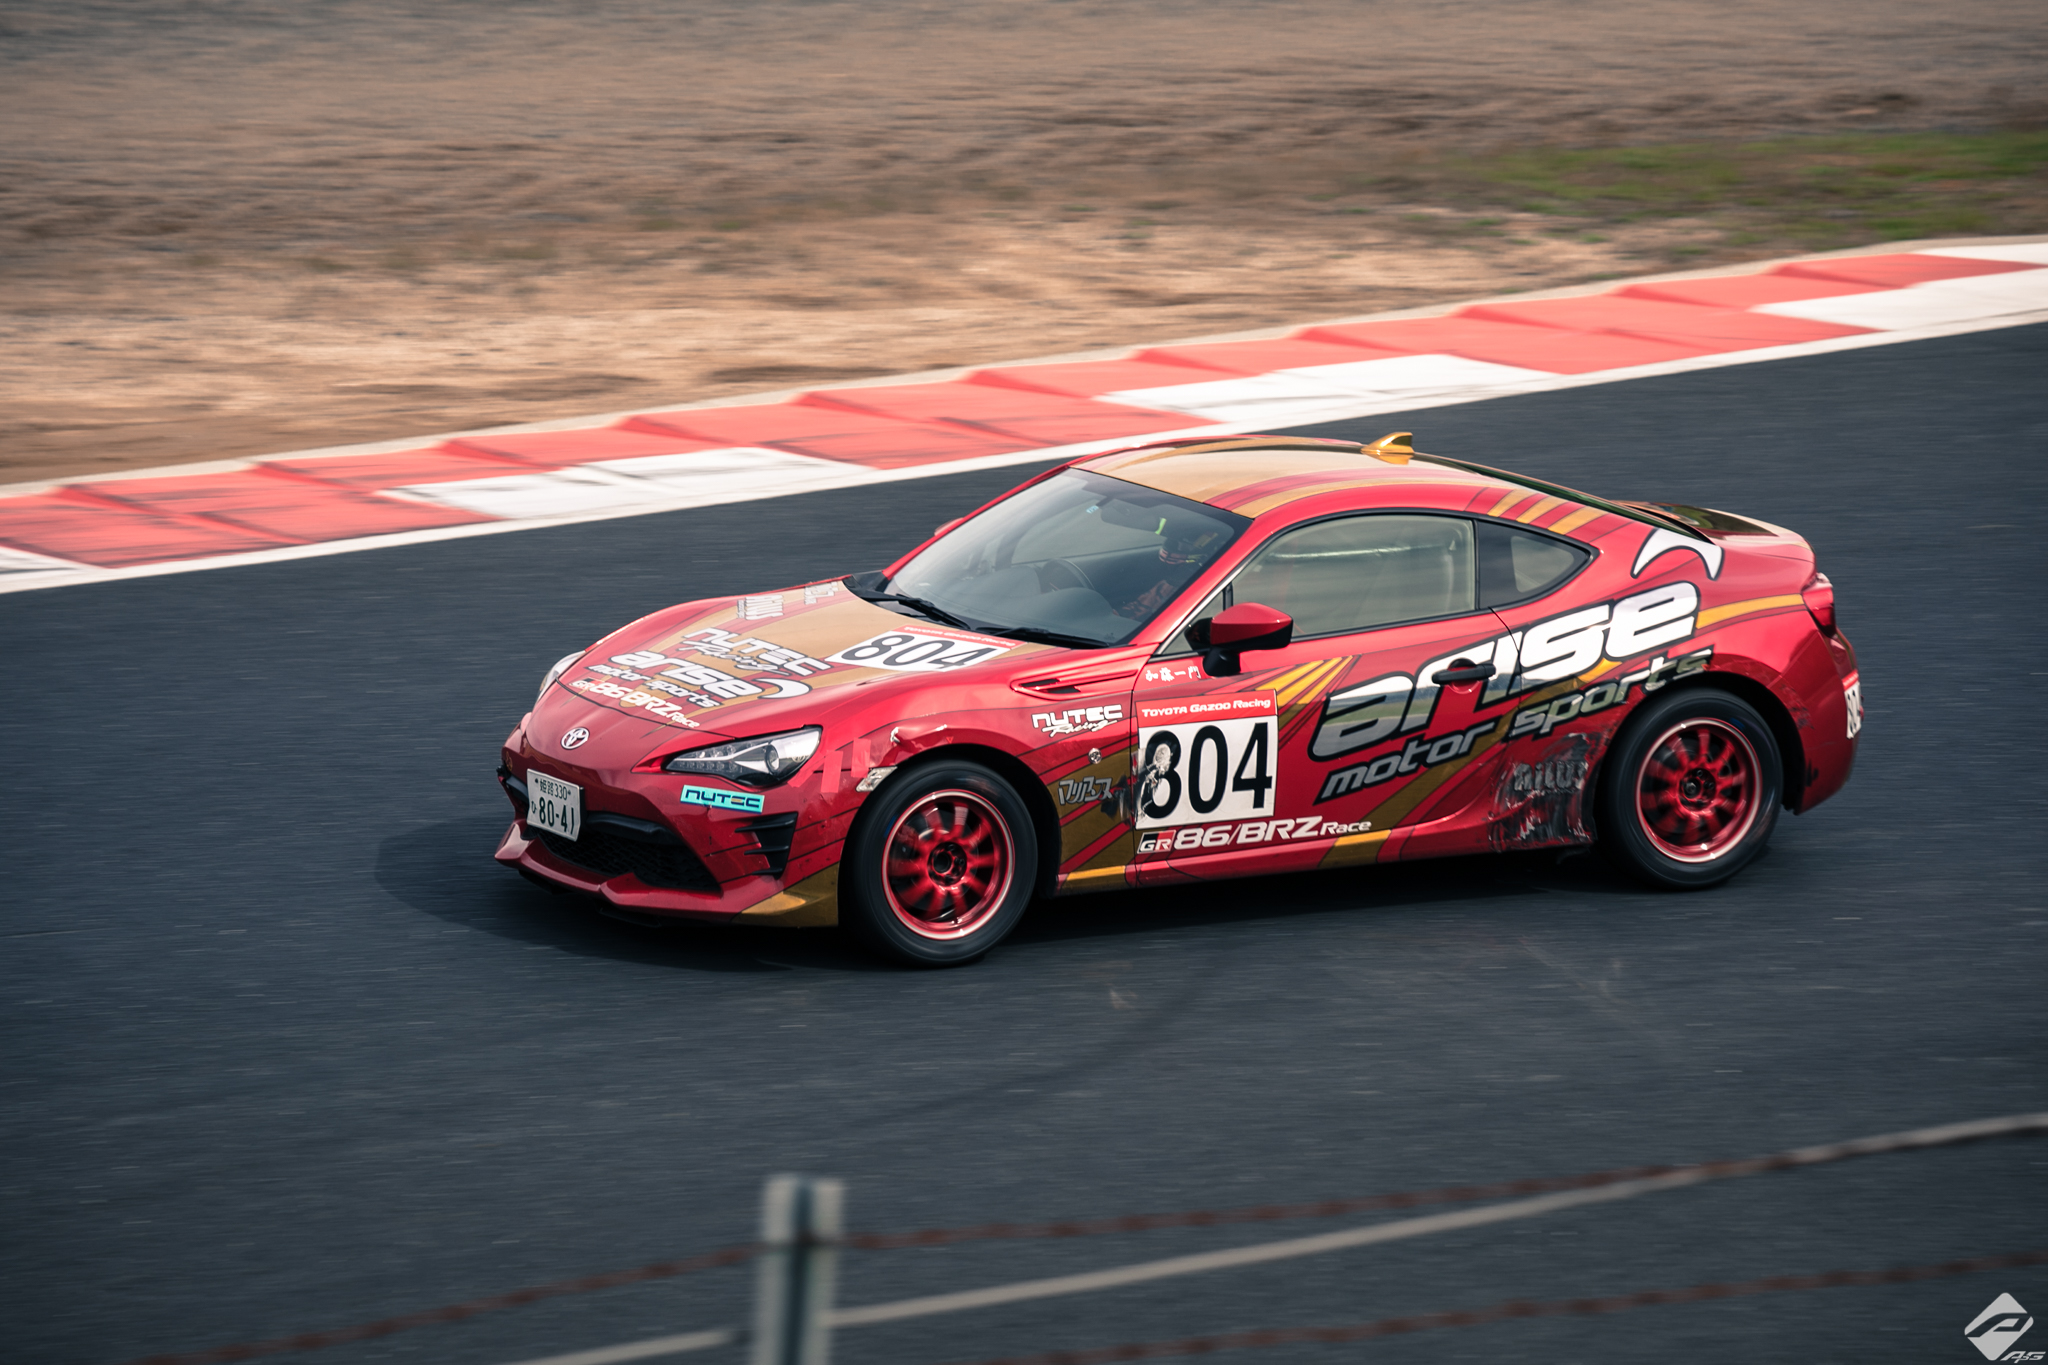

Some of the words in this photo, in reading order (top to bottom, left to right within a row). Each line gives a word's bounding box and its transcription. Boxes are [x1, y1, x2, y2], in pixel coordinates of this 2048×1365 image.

[841, 634, 998, 670] 804
[1310, 582, 1699, 760] arise
[585, 664, 653, 682] motor
[644, 680, 724, 708] sports
[609, 650, 765, 699] arise
[1142, 706, 1187, 718] TOYOTA
[1190, 702, 1231, 713] GAZOO
[1233, 699, 1271, 709] Racing
[1317, 719, 1499, 802] motor
[1510, 649, 1714, 738] sports
[1142, 722, 1273, 820] 804
[539, 796, 575, 835] 80-41
[1140, 836, 1172, 852] GR
[1173, 815, 1323, 849] 86/BRZ
[1318, 821, 1372, 836] Race
